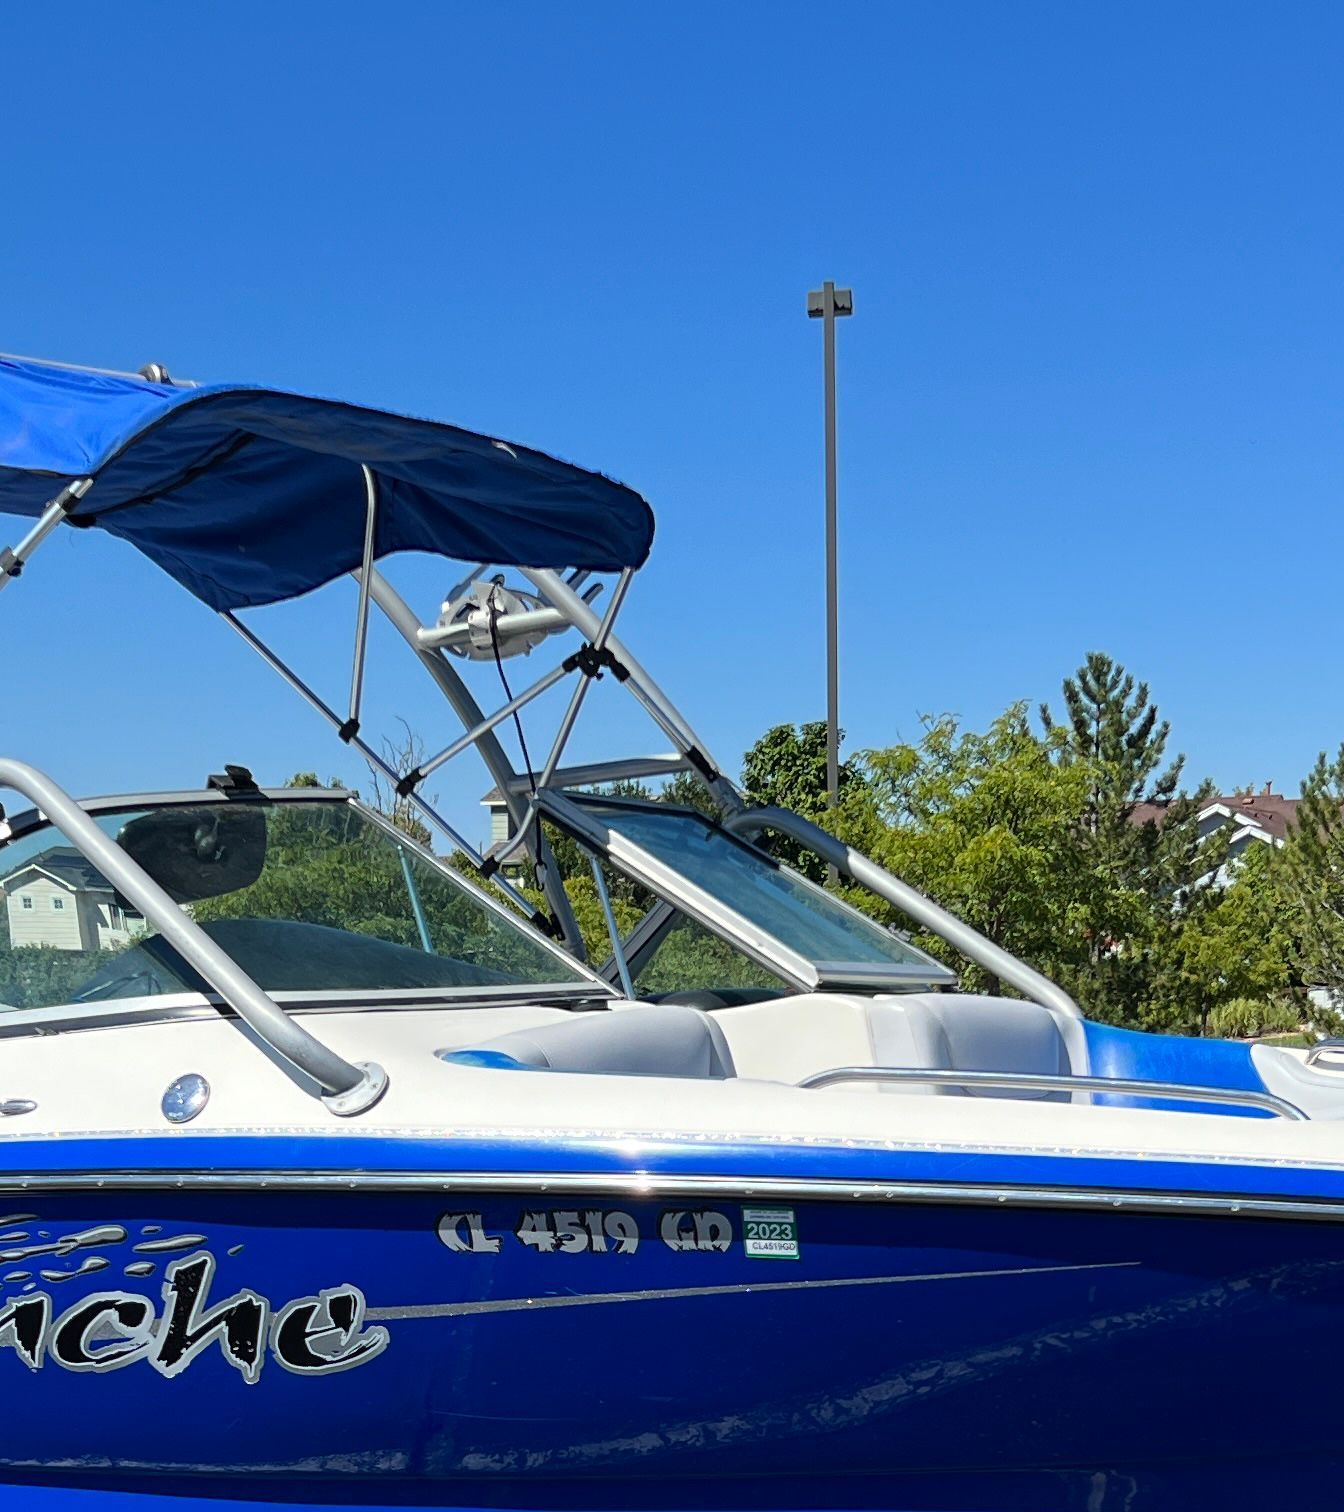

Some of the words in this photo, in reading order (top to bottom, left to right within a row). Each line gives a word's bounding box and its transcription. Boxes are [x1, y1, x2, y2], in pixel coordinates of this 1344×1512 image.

[434, 1209, 504, 1254] CL
[514, 1208, 640, 1255] 4519
[658, 1209, 734, 1254] GD
[746, 1222, 793, 1240] 2023
